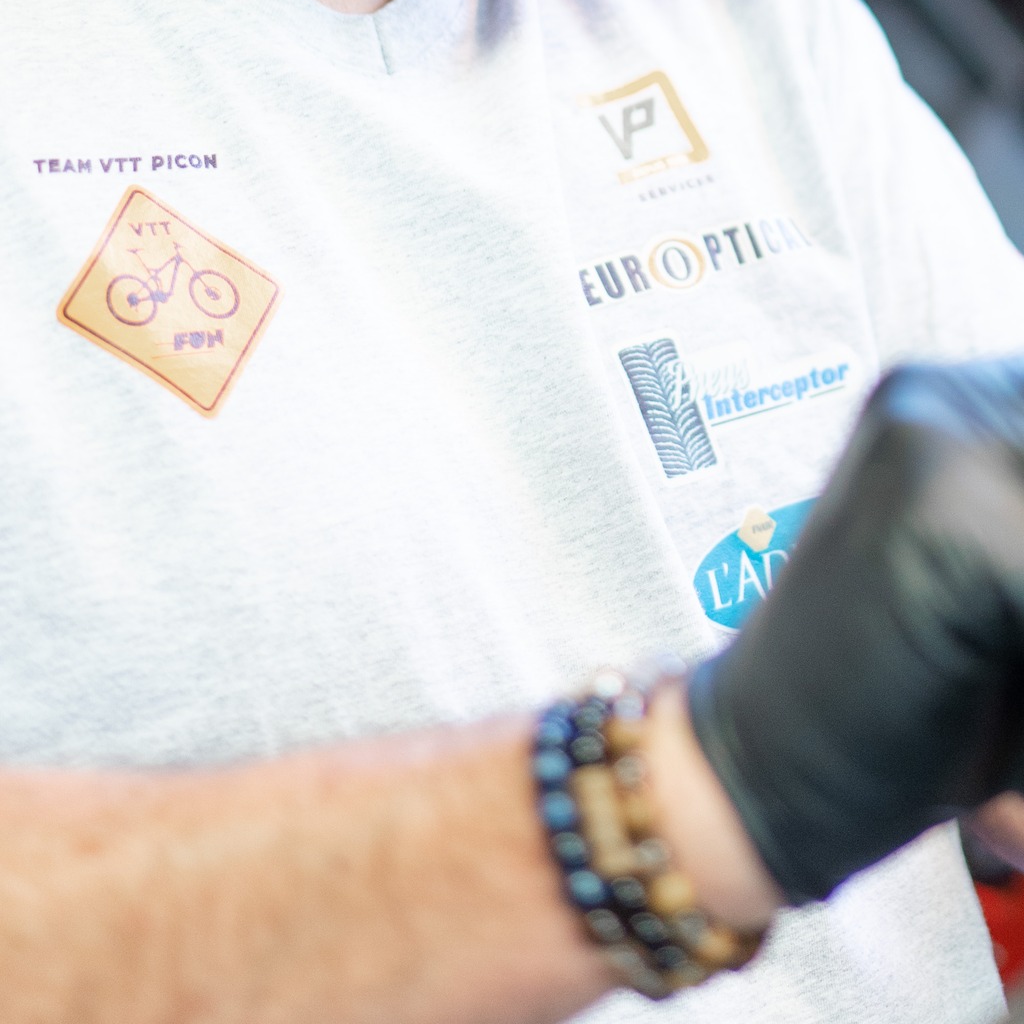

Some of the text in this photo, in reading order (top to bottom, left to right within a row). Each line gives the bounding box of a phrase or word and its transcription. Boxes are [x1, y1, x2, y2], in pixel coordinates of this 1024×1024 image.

[598, 97, 655, 160] VP
[33, 154, 218, 174] TEAM VTT PICON
[128, 221, 171, 236] VTT
[173, 329, 224, 351] FUN
[703, 363, 849, 420] Interceptor
